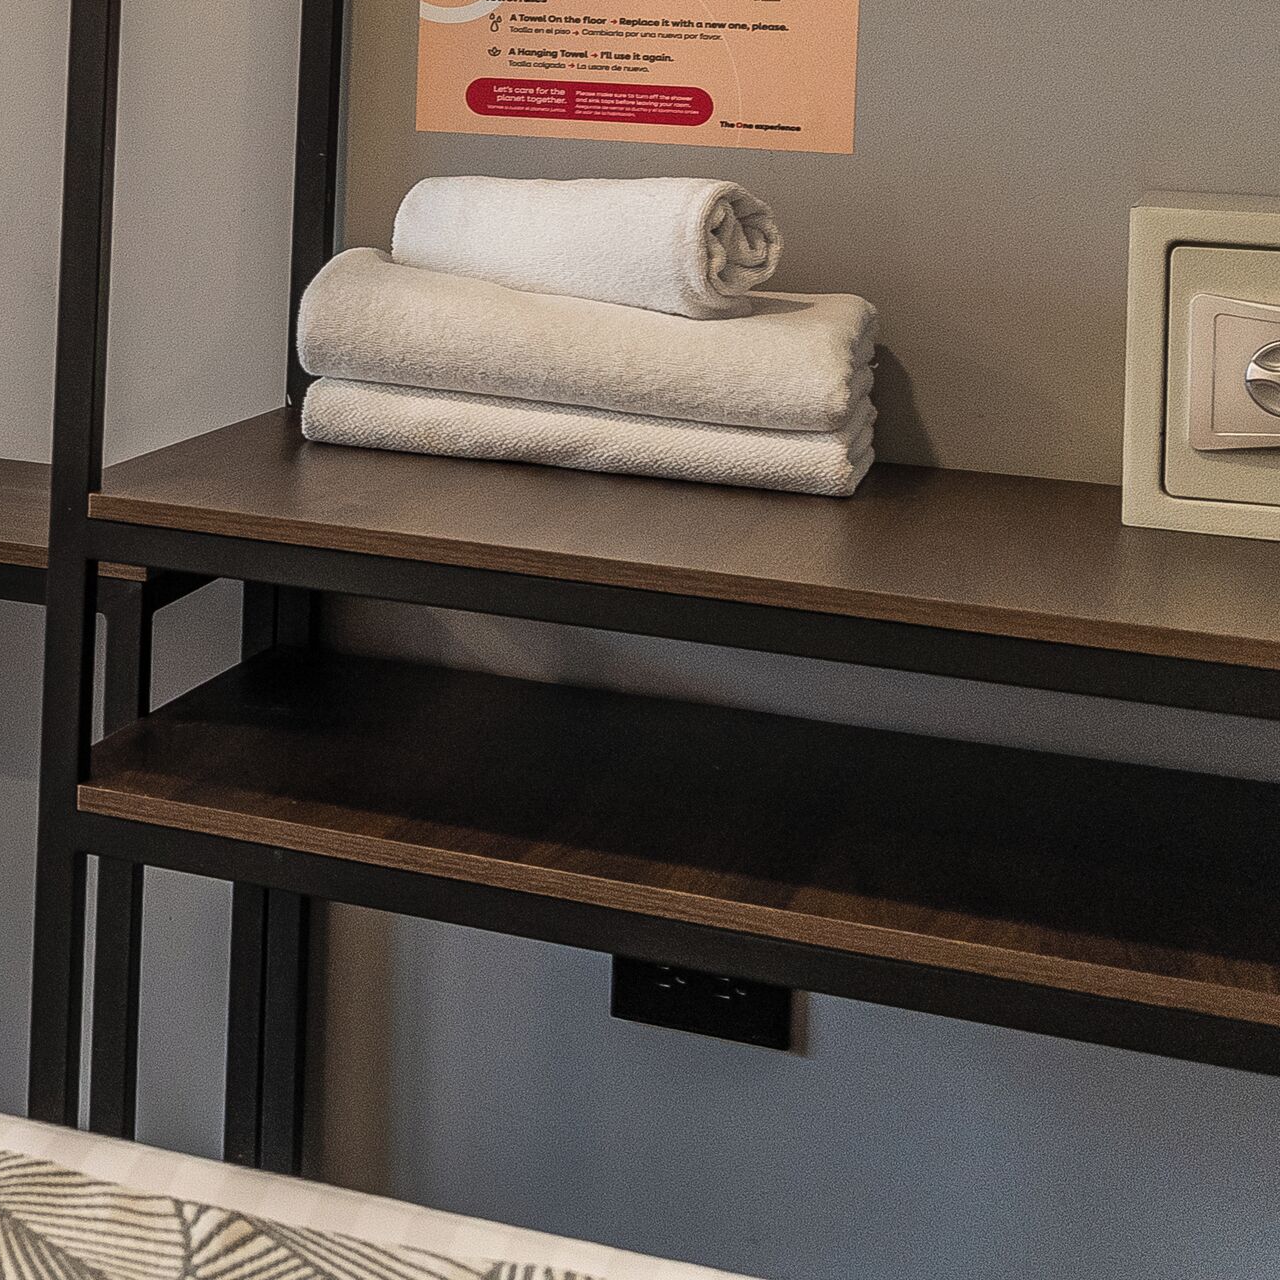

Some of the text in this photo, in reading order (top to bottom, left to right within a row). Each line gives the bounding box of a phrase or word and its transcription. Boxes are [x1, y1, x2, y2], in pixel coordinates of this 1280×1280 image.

[510, 14, 789, 32] A Towel On the floor Replace it with a new one, please.
[508, 48, 516, 56] A
[517, 48, 558, 58] Hanging
[560, 49, 588, 58] Towel
[632, 53, 641, 61] it
[642, 53, 674, 62] again.
[493, 85, 513, 93] Let's
[536, 86, 549, 95] for
[550, 87, 565, 95] the
[496, 94, 568, 104] planet together.
[720, 120, 735, 128] The
[754, 123, 801, 132] experience
